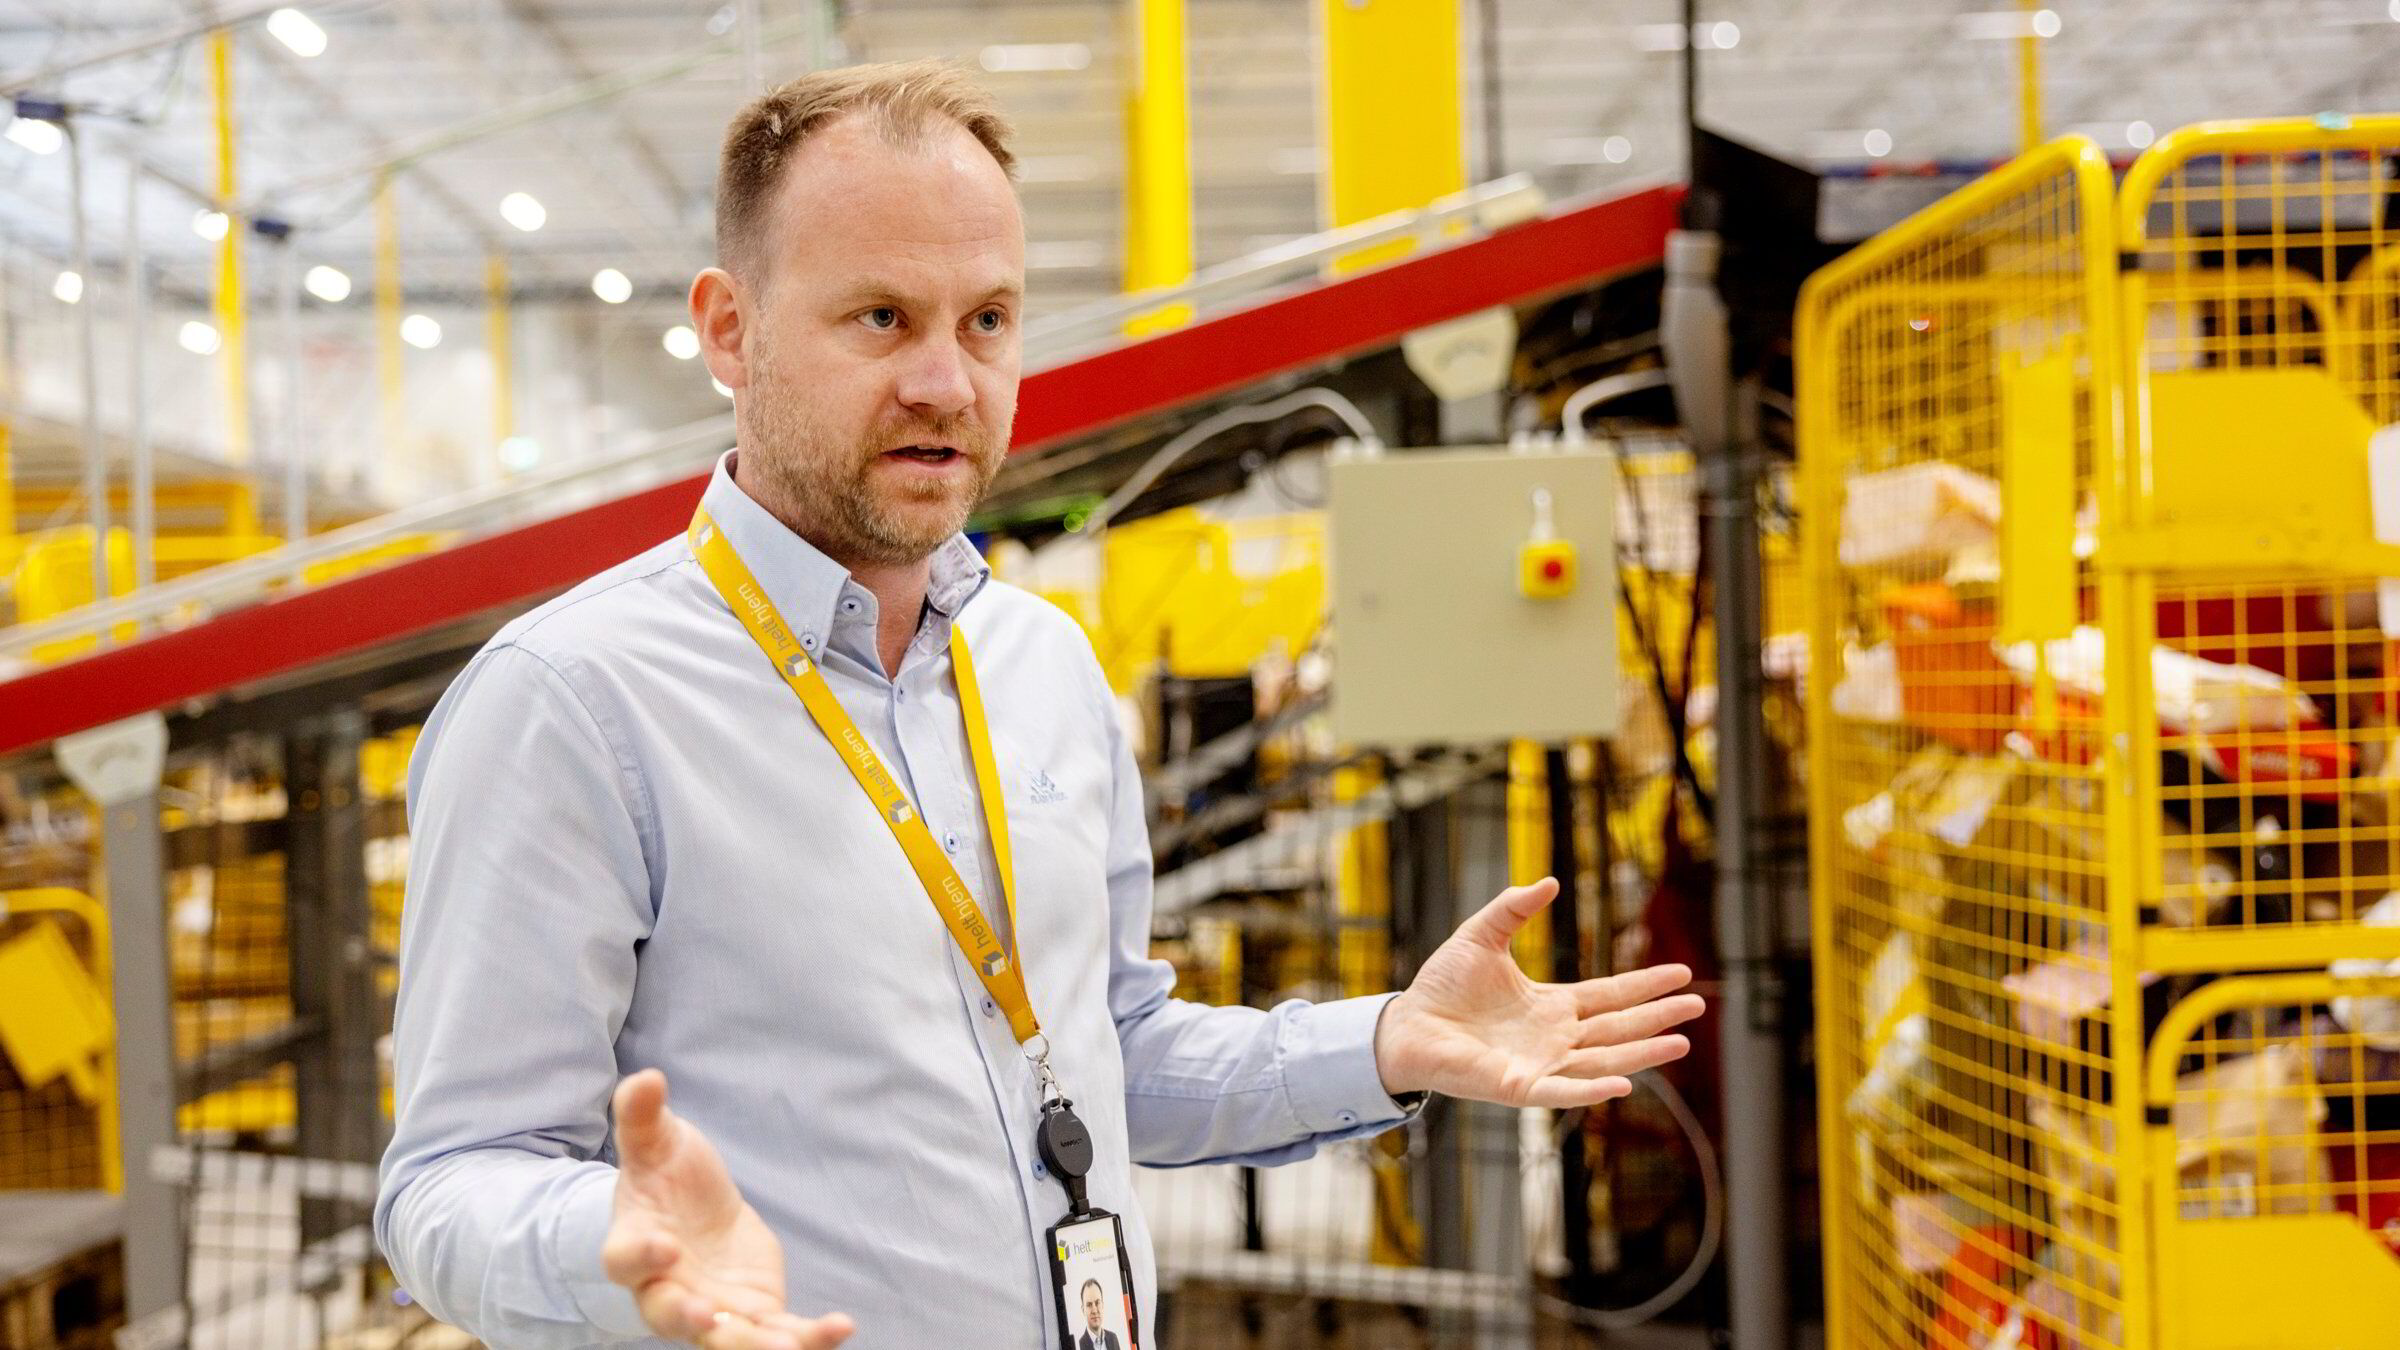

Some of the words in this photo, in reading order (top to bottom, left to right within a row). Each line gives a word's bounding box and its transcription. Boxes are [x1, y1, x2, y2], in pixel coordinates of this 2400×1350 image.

[738, 582, 791, 652] helthjem
[842, 728, 893, 798] helthjem
[942, 875, 991, 950] helthjem
